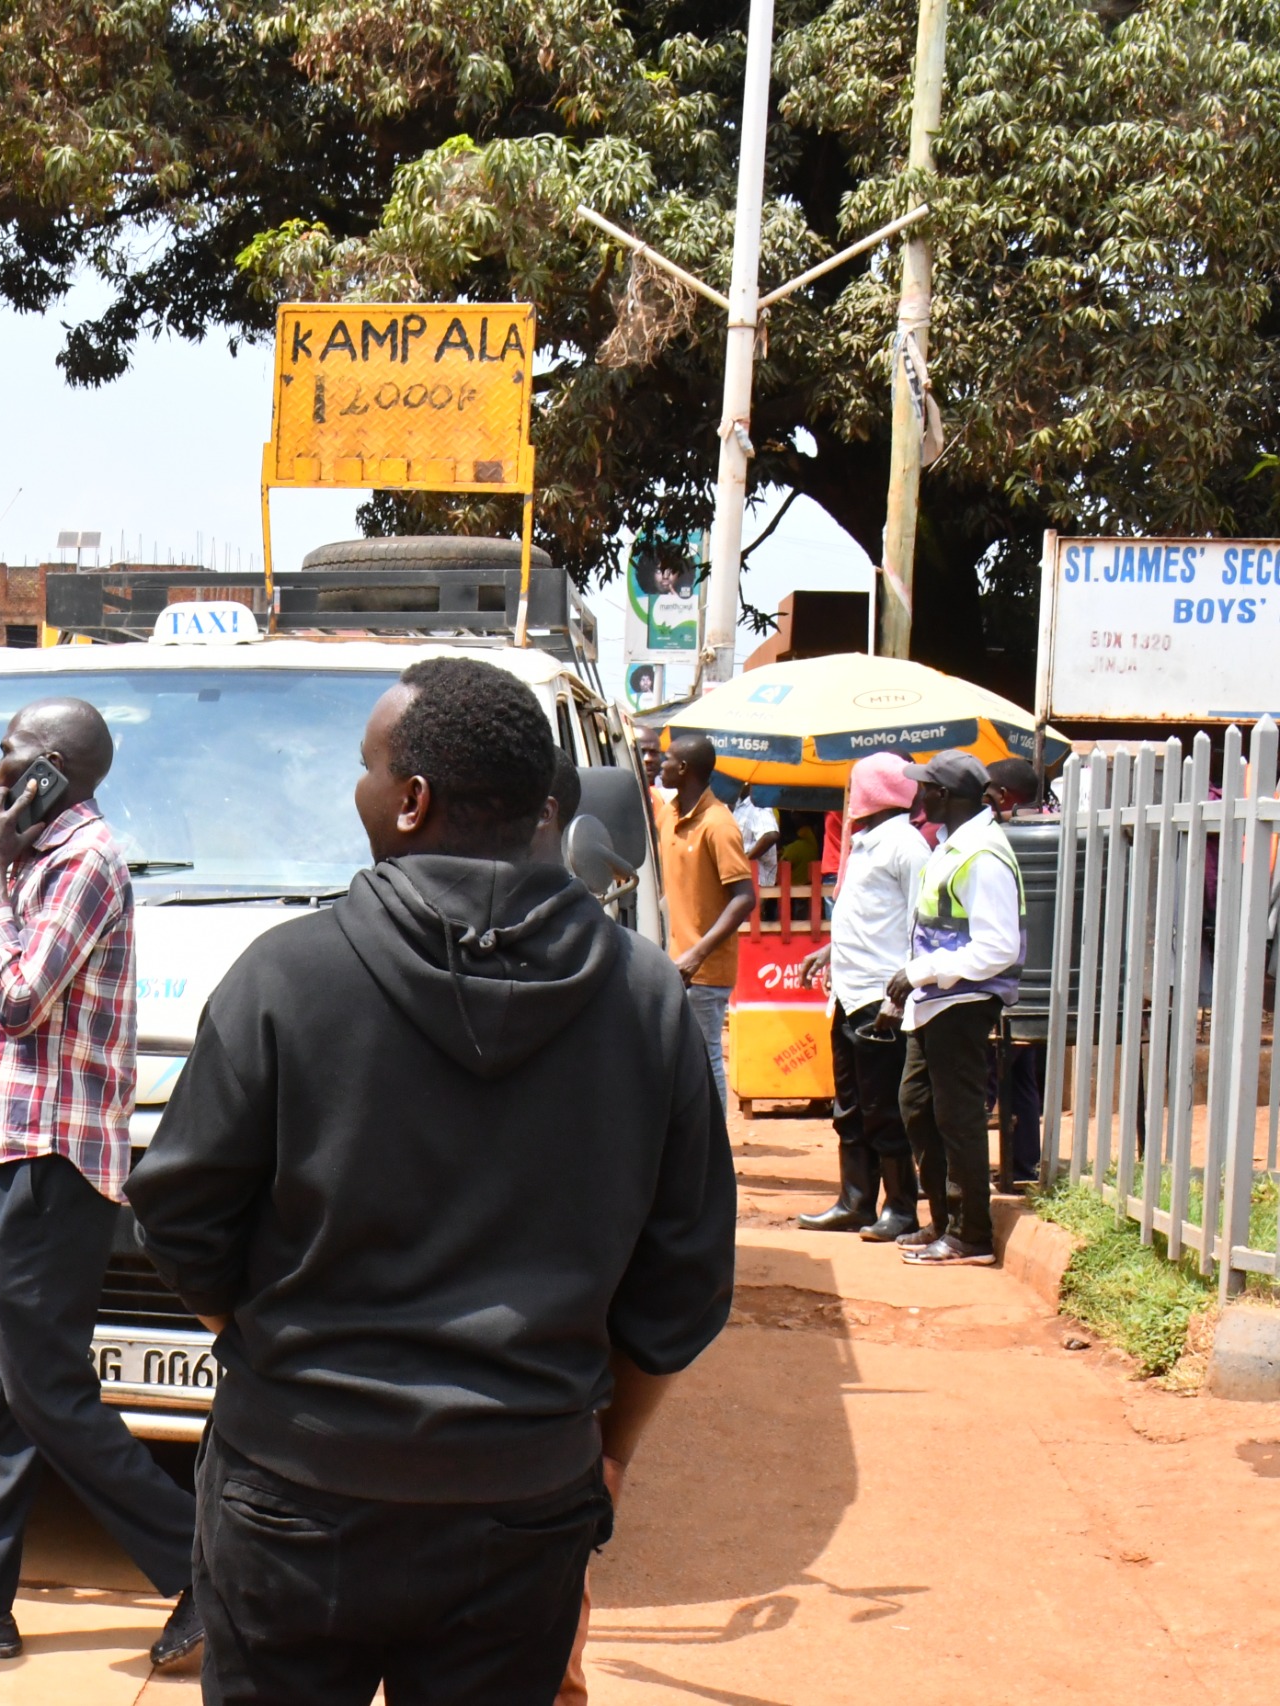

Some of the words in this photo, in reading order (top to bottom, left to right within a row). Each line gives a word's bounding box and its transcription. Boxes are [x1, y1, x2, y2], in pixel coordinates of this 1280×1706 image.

[291, 313, 526, 364] KAMPALA
[166, 611, 238, 634] TAXI
[870, 695, 905, 704] MTN
[850, 731, 897, 749] MoMo
[899, 725, 947, 744] Agent
[773, 1033, 814, 1066] MOBILE
[780, 1044, 817, 1075] MONEY
[143, 1348, 224, 1387] 006
